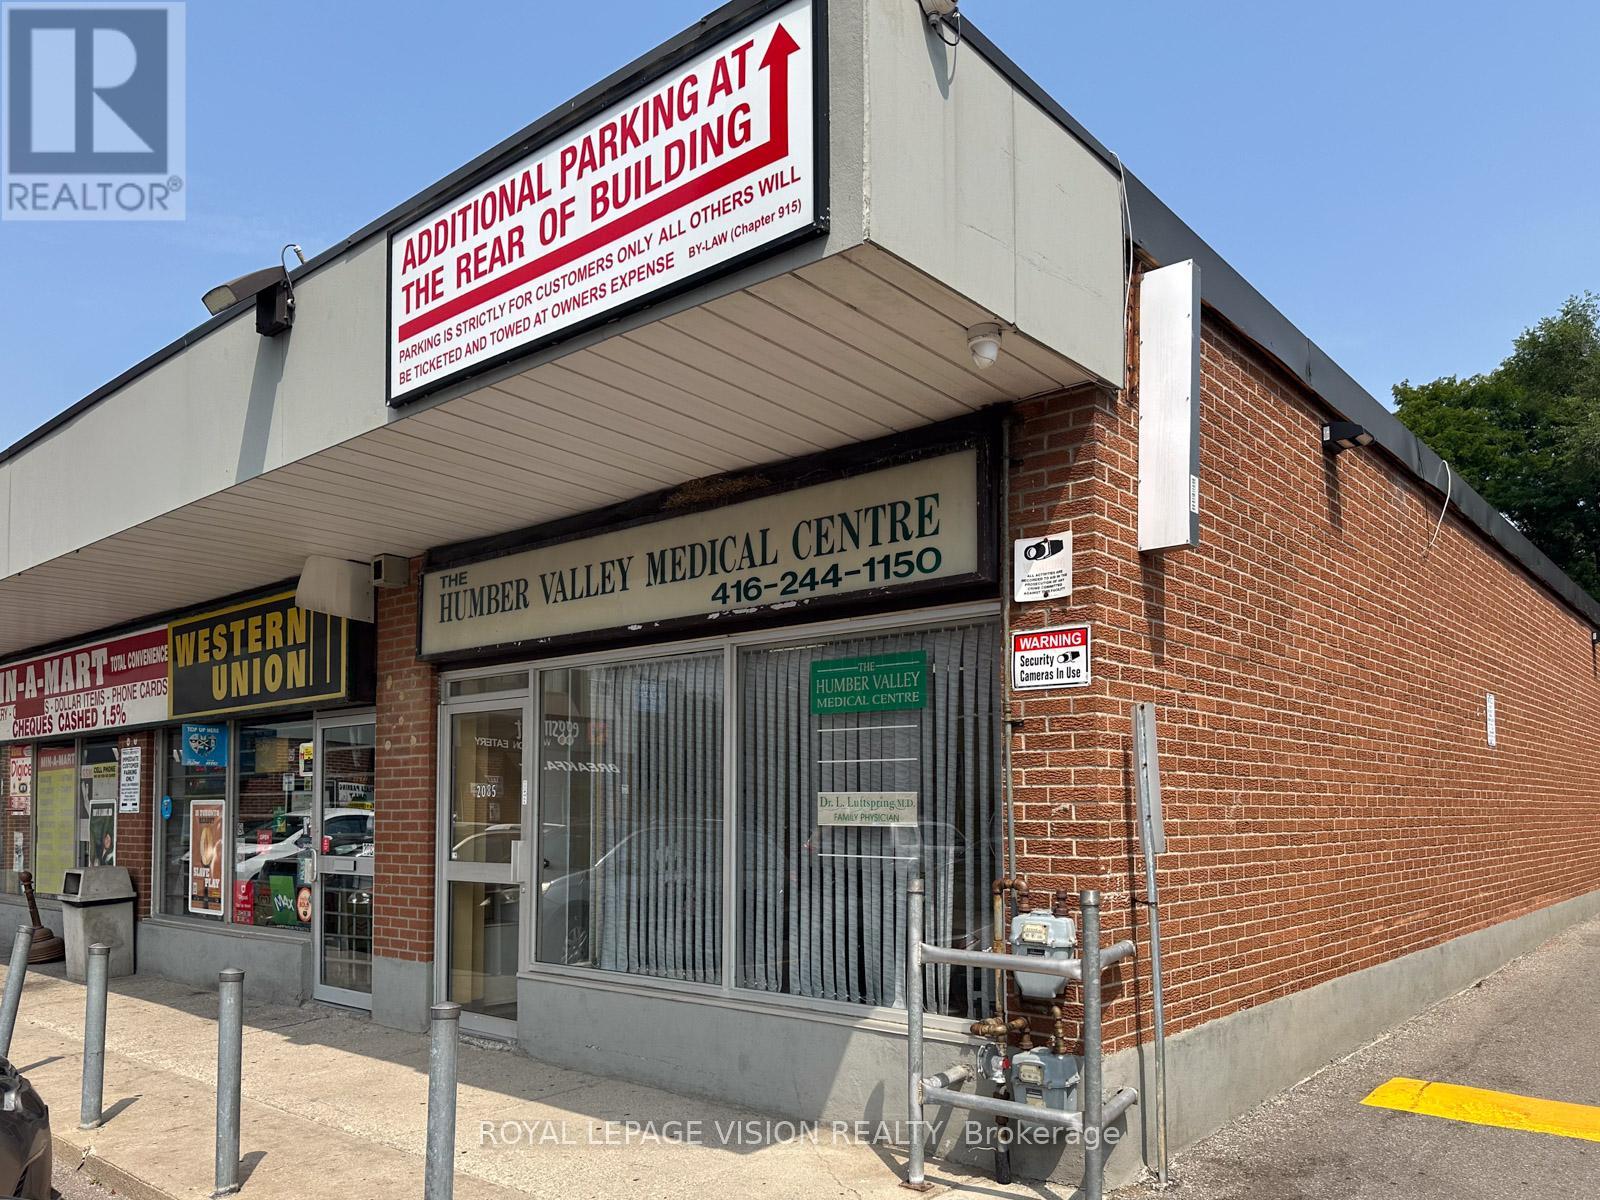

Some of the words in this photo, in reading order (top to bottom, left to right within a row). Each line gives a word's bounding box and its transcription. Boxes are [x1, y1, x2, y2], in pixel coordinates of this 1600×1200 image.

[401, 163, 552, 275] ADDITIONAL
[560, 78, 698, 188] PARKING
[707, 39, 754, 105] AT
[402, 272, 444, 315] THE
[456, 225, 524, 289] REAR
[540, 196, 576, 247] OF
[591, 102, 751, 223] BUILDING
[688, 230, 728, 259] BY-LAW
[730, 213, 776, 244] (Chapter
[778, 198, 802, 225] 915)
[399, 333, 441, 364] PARKING
[443, 326, 453, 344] IS
[455, 303, 507, 339] STRICTLY
[508, 294, 533, 316] FOR
[535, 254, 614, 301] CUSTOMERS
[617, 234, 653, 265] ONLY
[658, 219, 686, 246] ALL
[690, 185, 754, 229] OTHERS
[758, 165, 801, 198] WILL
[399, 368, 411, 386] BE
[414, 347, 462, 381] TICKETED
[464, 336, 487, 358] AND
[489, 315, 531, 350] TOWED
[533, 310, 548, 329] AT
[551, 282, 606, 320] OWNERS
[610, 253, 675, 294] EXPENSE
[438, 577, 530, 625] HUMBER
[539, 555, 635, 606] VALLEY
[646, 528, 779, 586] MEDICAL
[792, 493, 940, 561] CENTRE
[440, 570, 468, 588] THE
[710, 546, 943, 606] 416-244-1150
[175, 606, 306, 668] WESTERN
[1019, 631, 1082, 650] WARNING
[110, 654, 127, 673] TOTAL
[127, 644, 168, 669] CONVENIENCE
[858, 661, 875, 673] THE
[1019, 653, 1055, 668] Security
[211, 649, 306, 701] UNION
[816, 675, 869, 694] HUMBER
[873, 671, 920, 688] VALLEY
[1019, 669, 1054, 682] Cameras
[1056, 668, 1064, 679] In
[1066, 667, 1081, 679] Use
[54, 694, 82, 713] DOLLAR
[83, 690, 105, 707] ITEMS
[112, 683, 138, 704] PHONE
[139, 678, 168, 700] CARDS
[817, 694, 869, 710] MEDICAL
[872, 691, 920, 706] CENTRE
[12, 714, 53, 738] CHEQUES
[58, 707, 98, 732] CASHED
[102, 702, 127, 727] 1.5%
[476, 784, 496, 798] 2085
[820, 796, 833, 807] Dr.
[836, 796, 845, 807] L.
[834, 813, 858, 821] FAMILY
[860, 813, 900, 822] PHYSICIAN
[204, 878, 221, 889] PLAY
